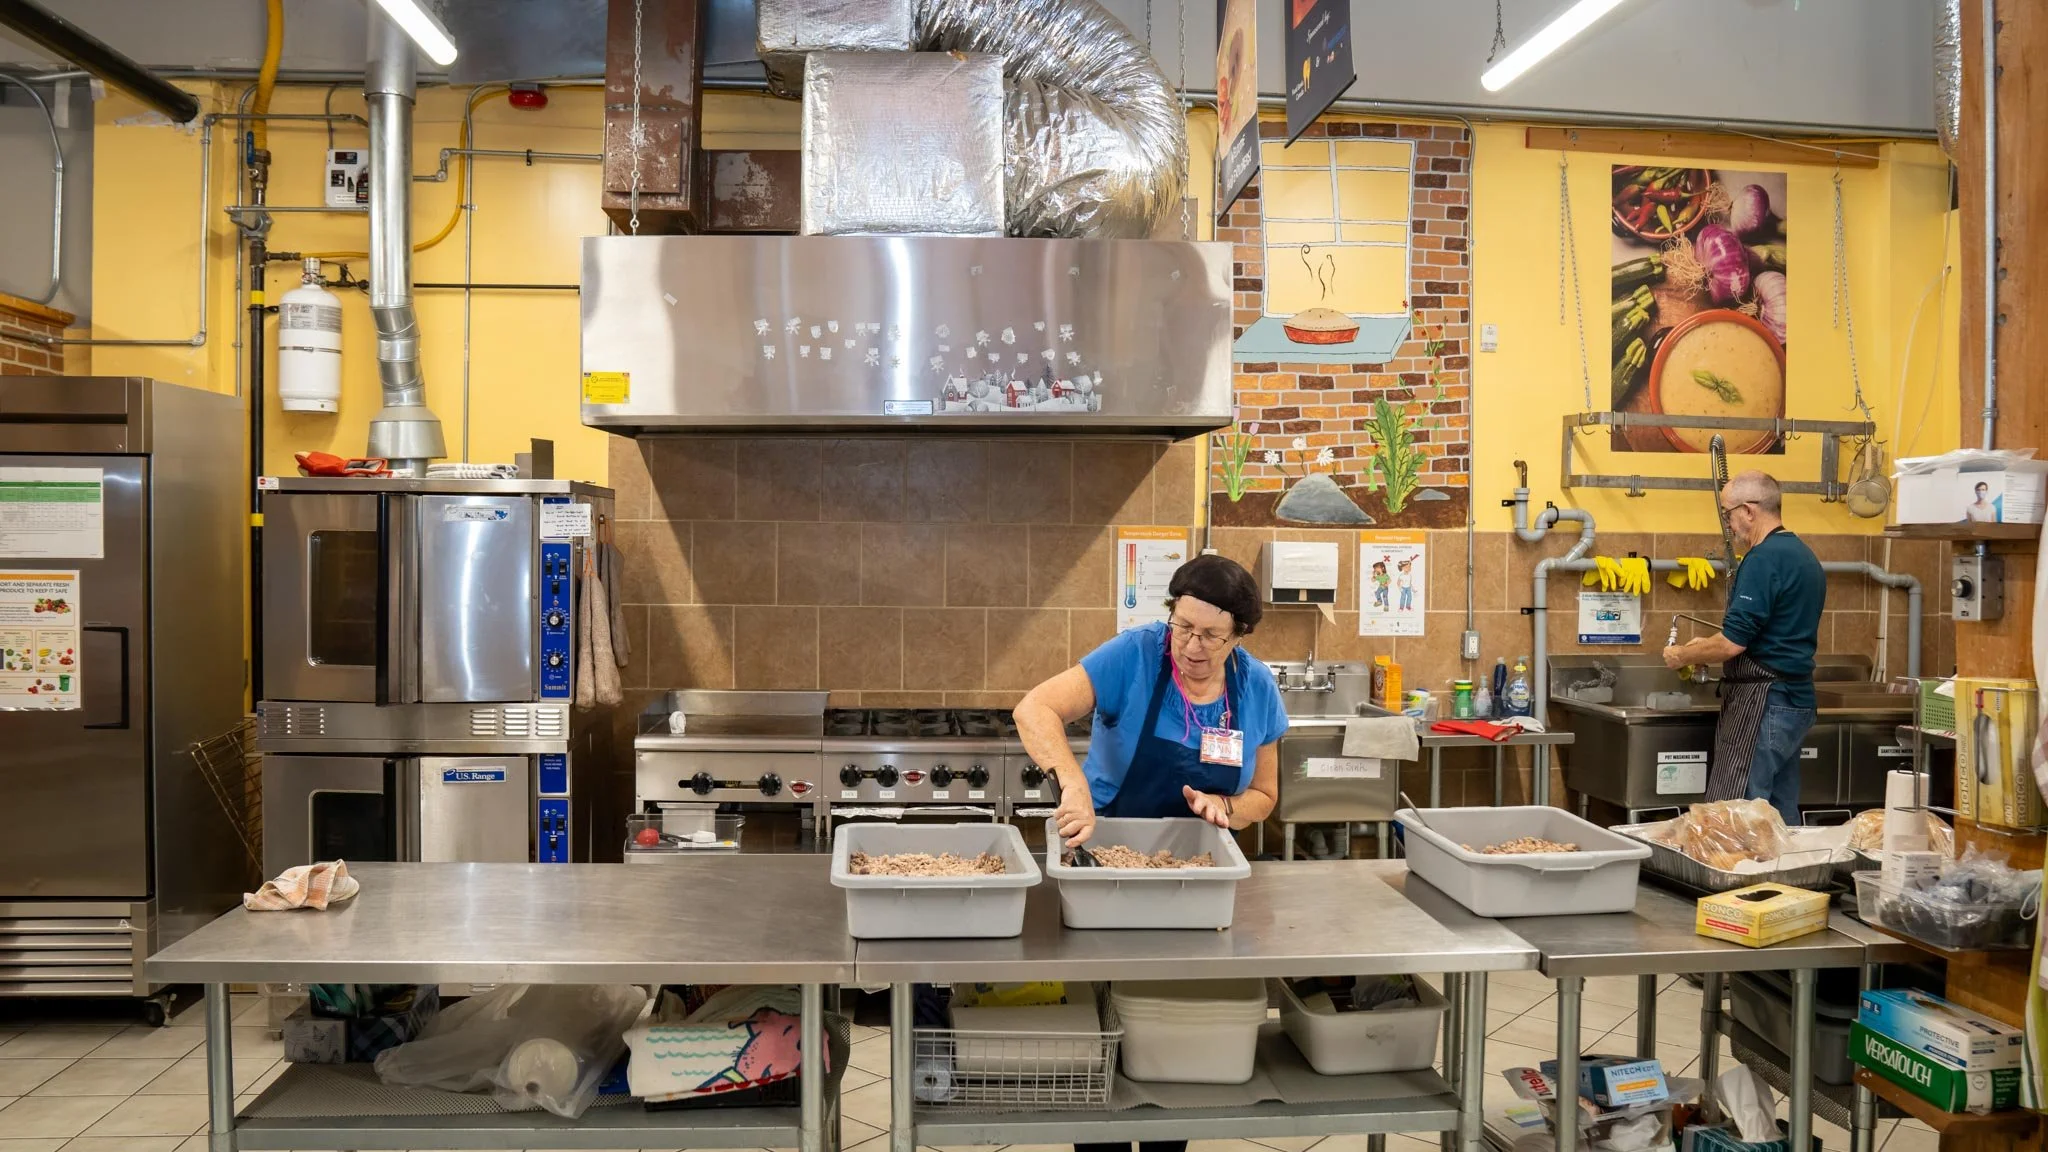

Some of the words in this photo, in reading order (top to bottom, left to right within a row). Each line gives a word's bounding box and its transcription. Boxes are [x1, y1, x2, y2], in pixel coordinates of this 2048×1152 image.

[455, 772, 471, 780] U.S.
[471, 772, 495, 781] Range
[1960, 754, 1970, 816] RONCO
[2016, 773, 2026, 826] RONCO
[1702, 902, 1743, 919] RONCO
[1919, 1026, 1960, 1048] PROTECTIVE
[1610, 1066, 1641, 1077] NITECH
[1865, 1034, 1932, 1087] VERSATOUCH
